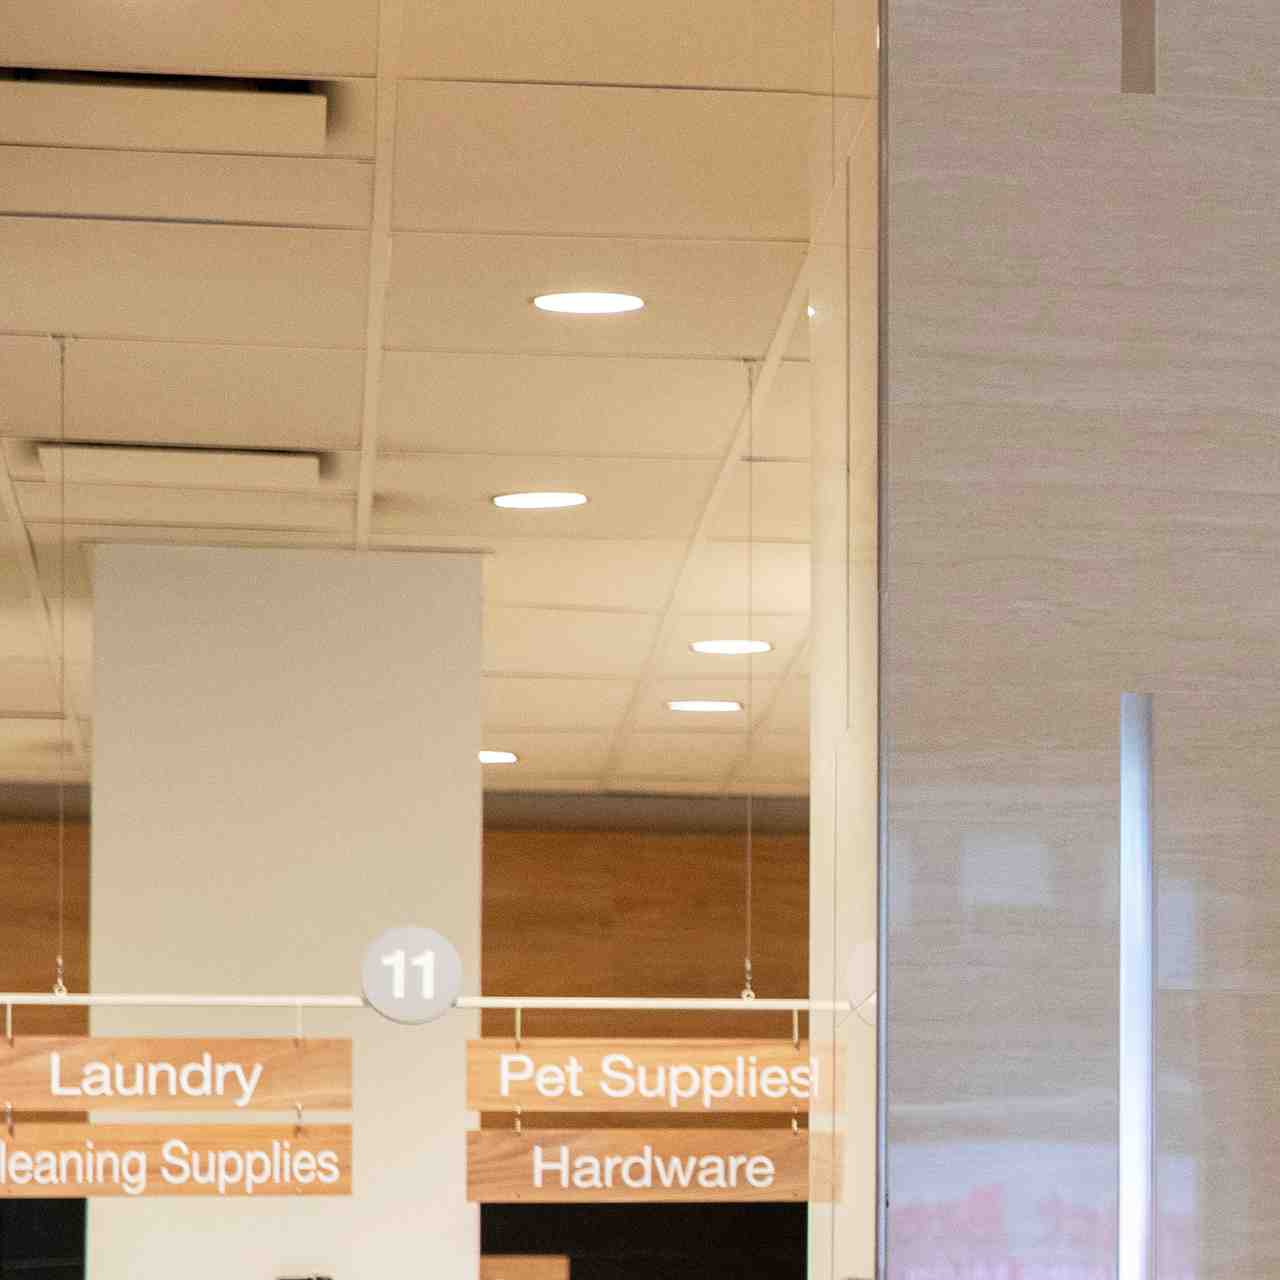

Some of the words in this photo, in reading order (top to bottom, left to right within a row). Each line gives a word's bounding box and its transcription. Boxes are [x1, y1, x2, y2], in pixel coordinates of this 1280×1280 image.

[381, 951, 437, 999] 11
[50, 1052, 264, 1108] Laundry
[499, 1054, 584, 1098] Pet
[600, 1053, 819, 1108] Supplies
[160, 1138, 341, 1194] Supplies
[532, 1144, 776, 1188] Hardware
